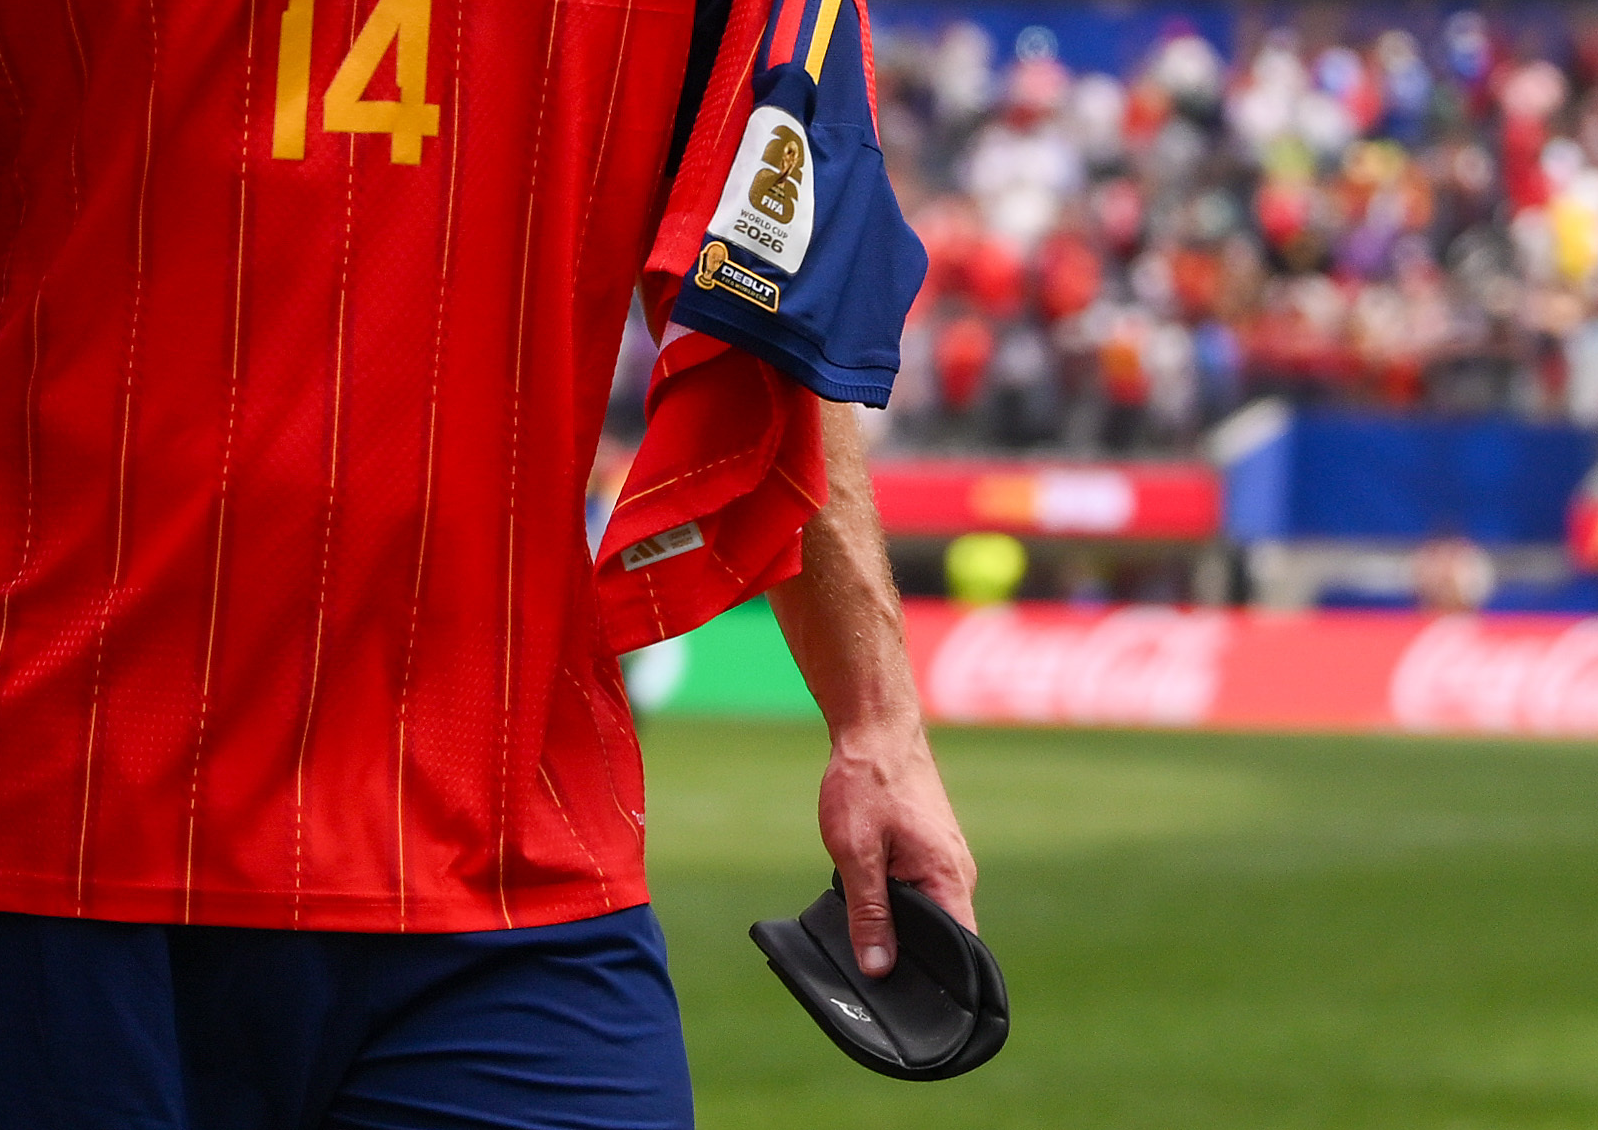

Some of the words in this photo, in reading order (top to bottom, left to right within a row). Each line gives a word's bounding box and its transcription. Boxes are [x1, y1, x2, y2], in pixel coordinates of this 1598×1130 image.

[760, 194, 784, 216] FIFA
[733, 218, 785, 254] 2026
[740, 209, 772, 231] WORLD
[772, 226, 789, 239] CUP
[721, 265, 774, 297] DEBUT
